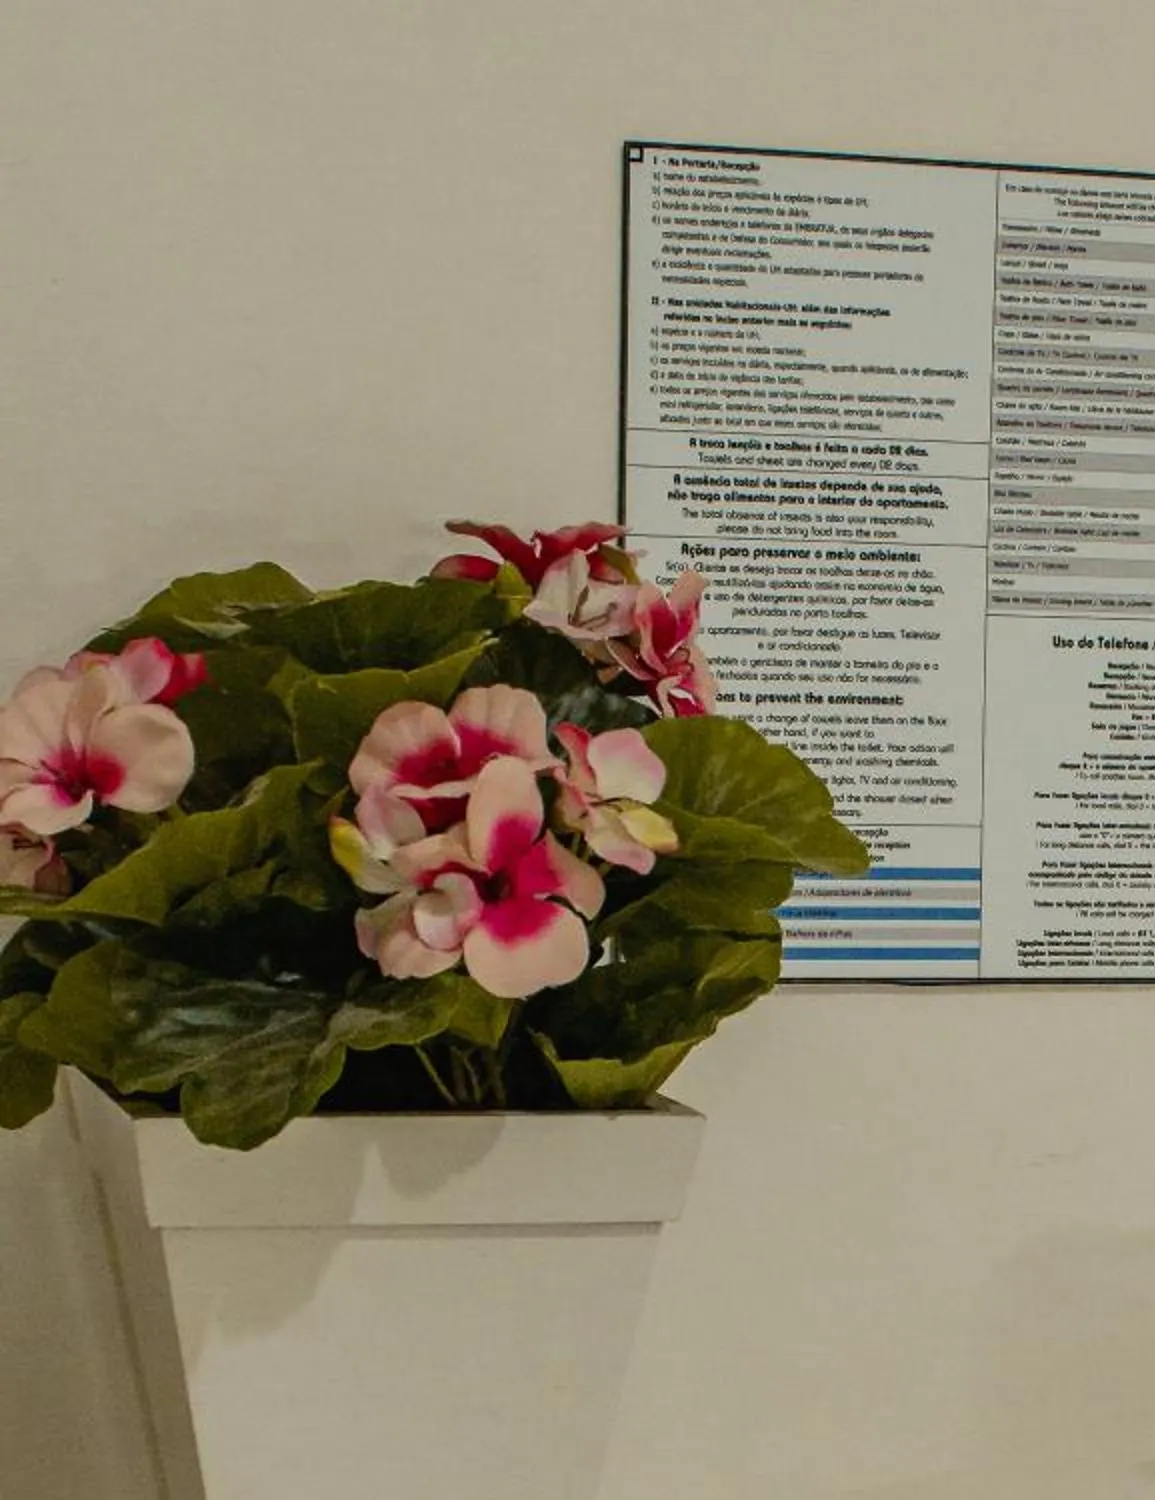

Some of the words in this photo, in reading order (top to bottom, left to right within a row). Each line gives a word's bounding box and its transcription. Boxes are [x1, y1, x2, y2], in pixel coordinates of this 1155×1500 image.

[673, 473, 681, 485] A
[683, 475, 731, 487] ausência
[732, 477, 760, 488] total
[762, 477, 777, 488] de
[779, 478, 817, 490] insetos
[818, 480, 868, 492] depende
[870, 481, 885, 492] de
[887, 484, 906, 493] sua
[908, 483, 943, 496] ajuda,
[667, 489, 688, 500] não
[690, 491, 721, 503] traga
[723, 491, 776, 503] alimentos
[778, 495, 805, 505] para
[807, 495, 815, 504] o
[817, 494, 856, 506] interior
[858, 495, 874, 507] do
[875, 498, 949, 509] apartamento.
[680, 542, 716, 558] Ações
[718, 547, 750, 559] para
[752, 548, 811, 559] preservar
[814, 549, 823, 559] o
[825, 548, 856, 560] meio
[858, 549, 921, 562] ambiente:
[1052, 635, 1074, 648] Uso
[1077, 635, 1095, 649] do
[1096, 636, 1149, 650] Telefone
[738, 691, 752, 703] to
[754, 693, 802, 705] prevent
[826, 694, 904, 705] environment:
